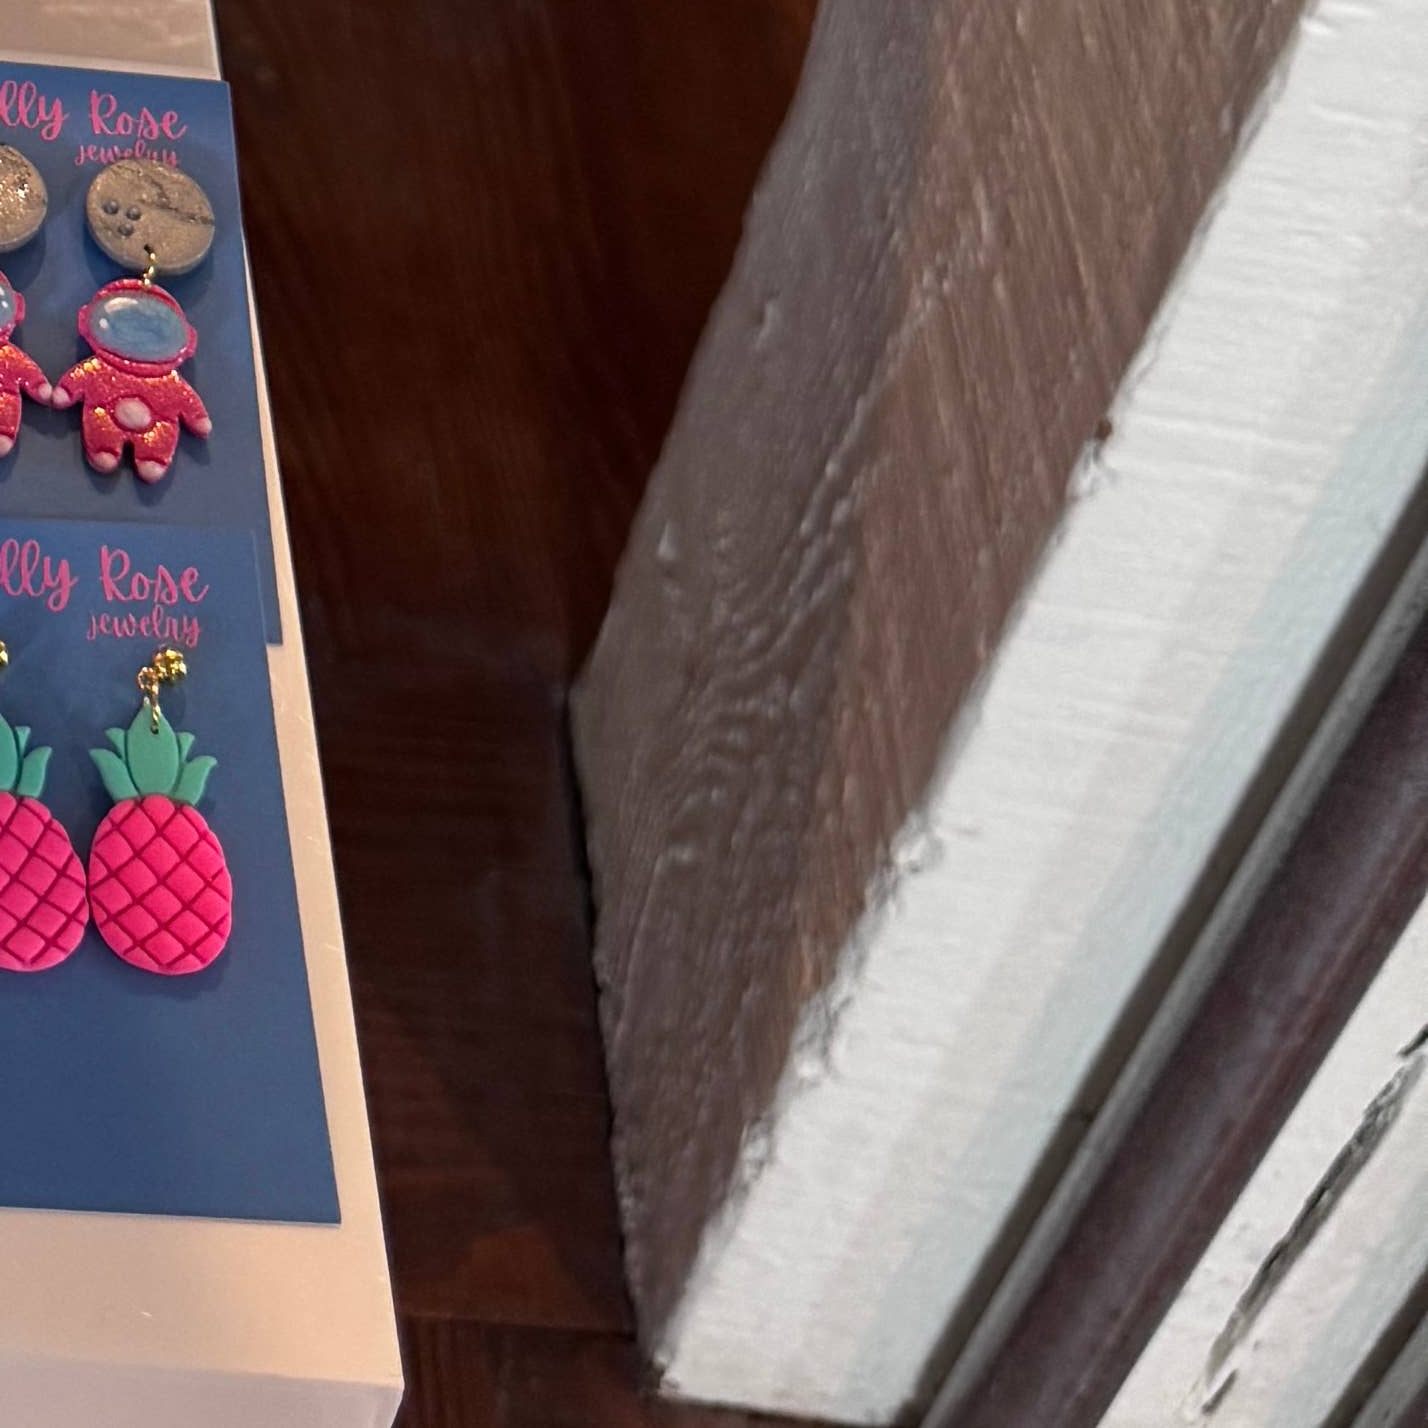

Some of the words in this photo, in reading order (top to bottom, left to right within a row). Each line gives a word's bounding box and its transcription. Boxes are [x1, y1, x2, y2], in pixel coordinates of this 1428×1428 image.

[89, 89, 189, 141] Rose
[98, 544, 210, 606] Rose
[86, 602, 203, 649] jewelry
